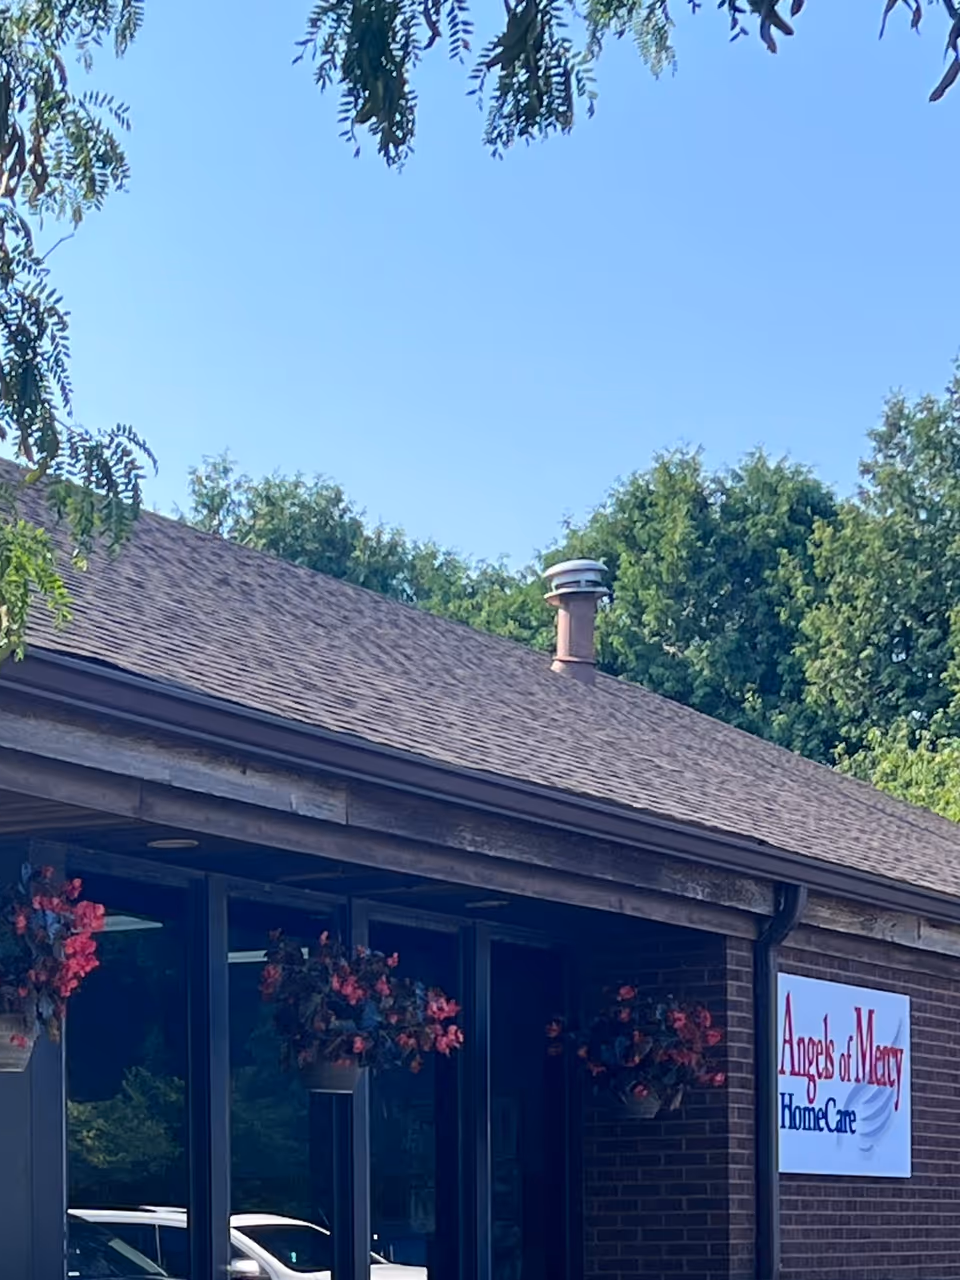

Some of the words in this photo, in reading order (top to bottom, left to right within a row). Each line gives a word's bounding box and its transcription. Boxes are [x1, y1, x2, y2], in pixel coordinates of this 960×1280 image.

[778, 991, 834, 1104] Angels
[840, 1035, 854, 1082] of
[854, 1006, 904, 1111] Mercy
[779, 1093, 856, 1134] HomeCare
